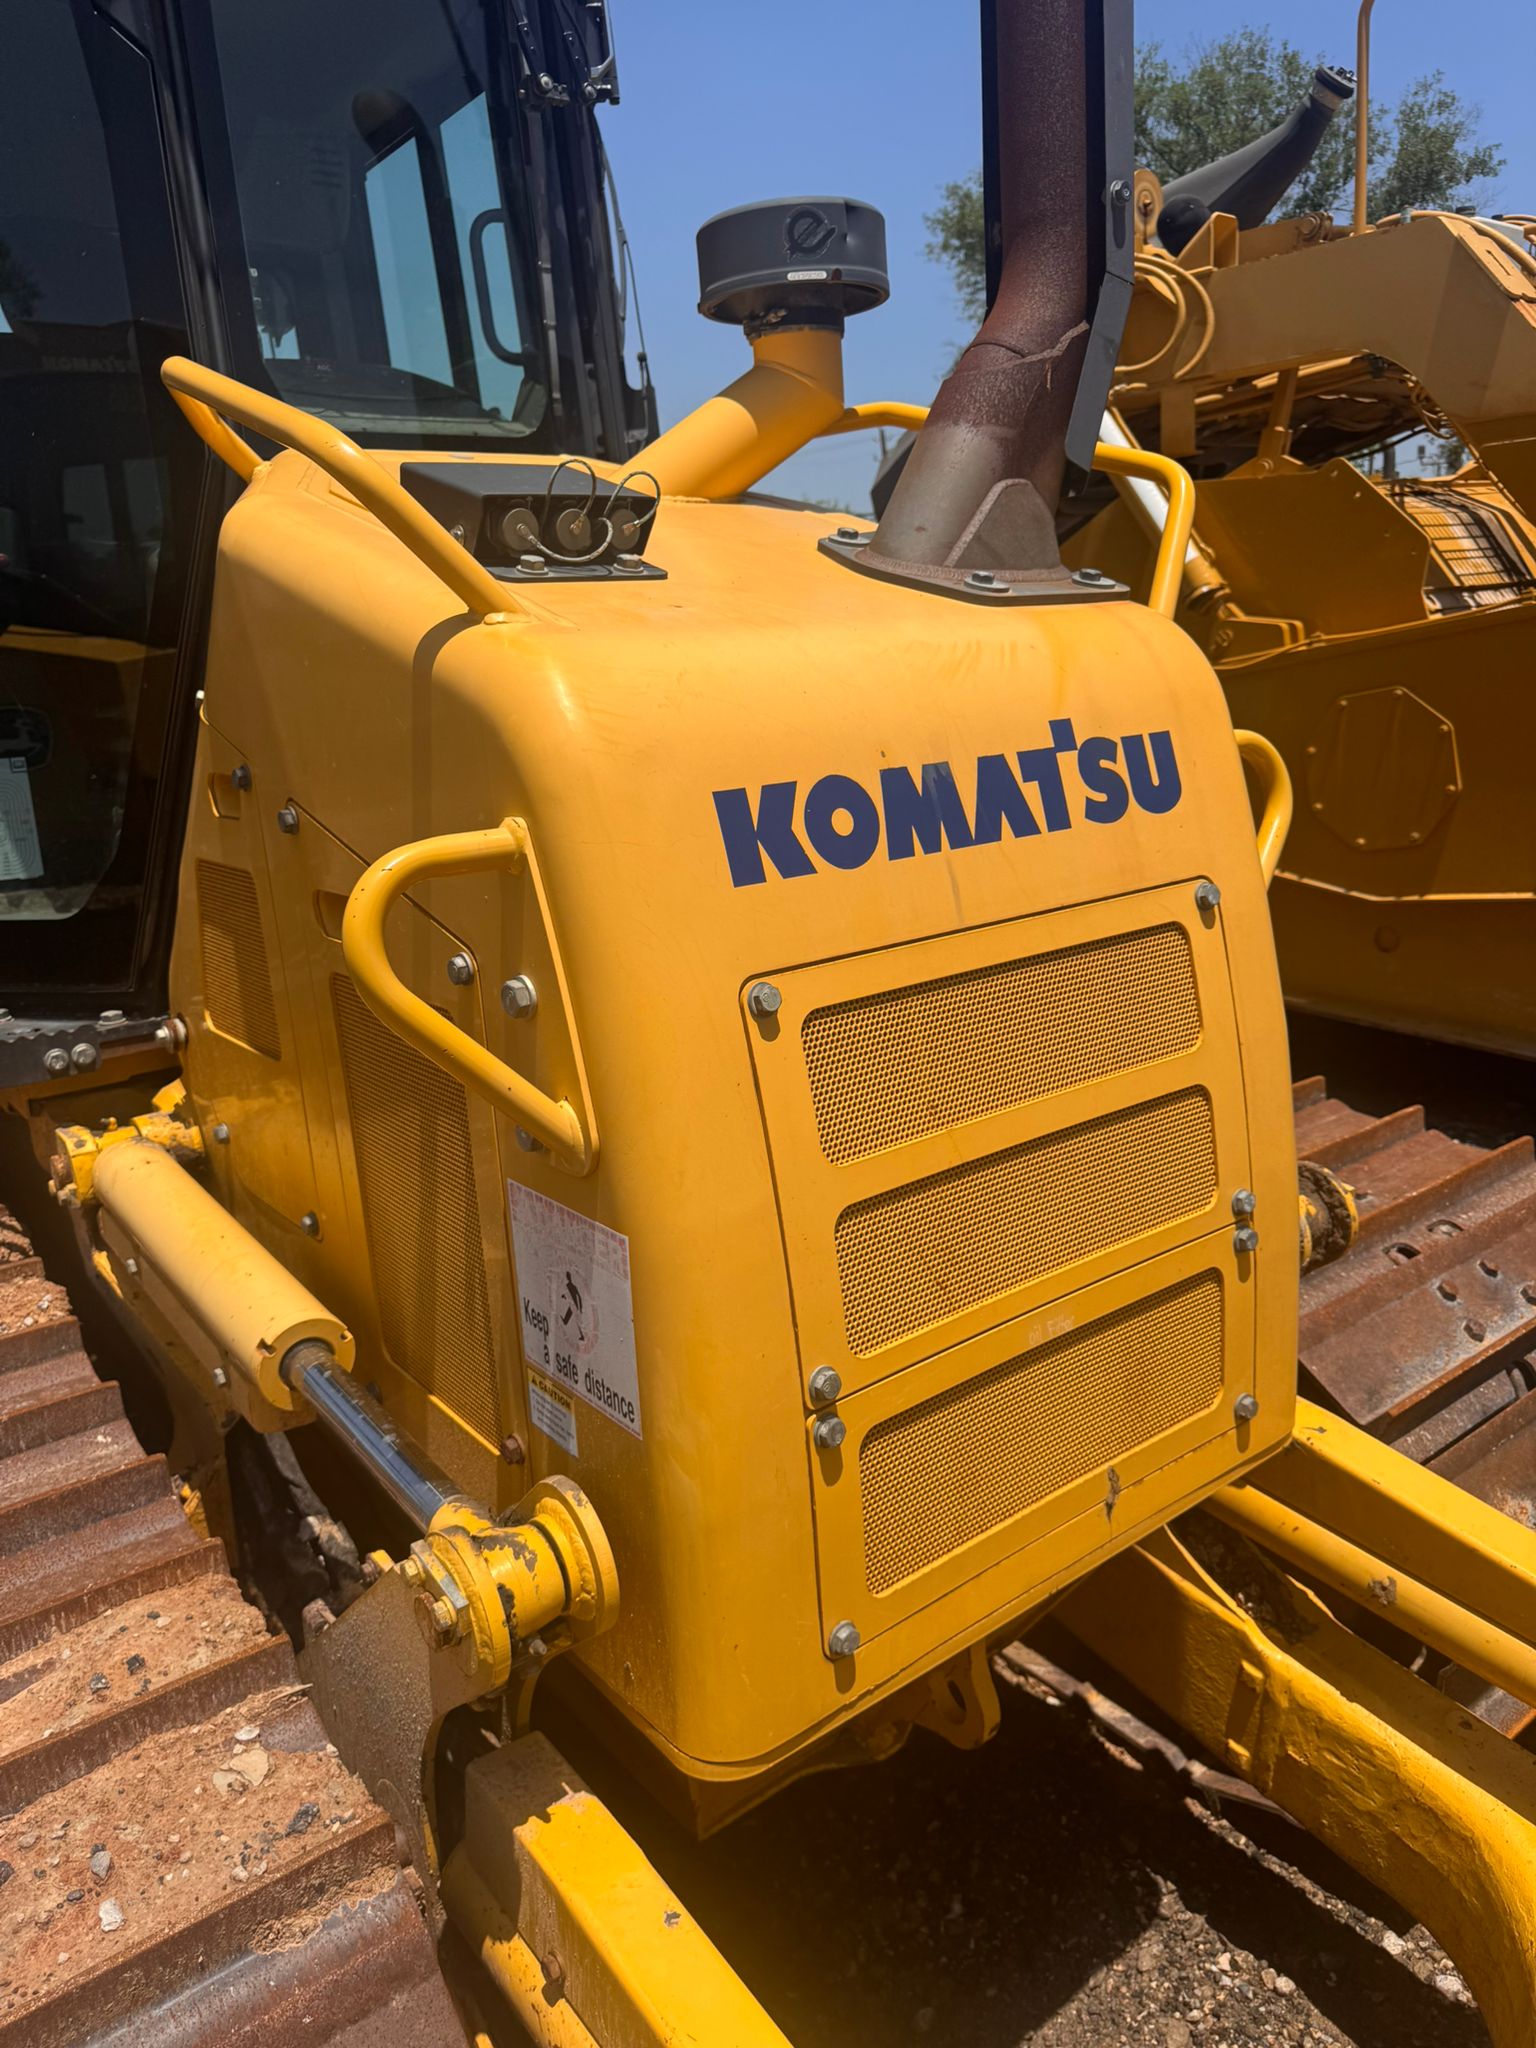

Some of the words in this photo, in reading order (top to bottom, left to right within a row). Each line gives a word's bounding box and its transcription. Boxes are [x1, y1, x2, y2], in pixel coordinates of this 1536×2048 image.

[714, 719, 1181, 887] KOMATSU
[523, 1297, 549, 1341] Keep
[544, 1344, 550, 1365] a
[556, 1351, 579, 1385] safe
[584, 1367, 636, 1424] distance
